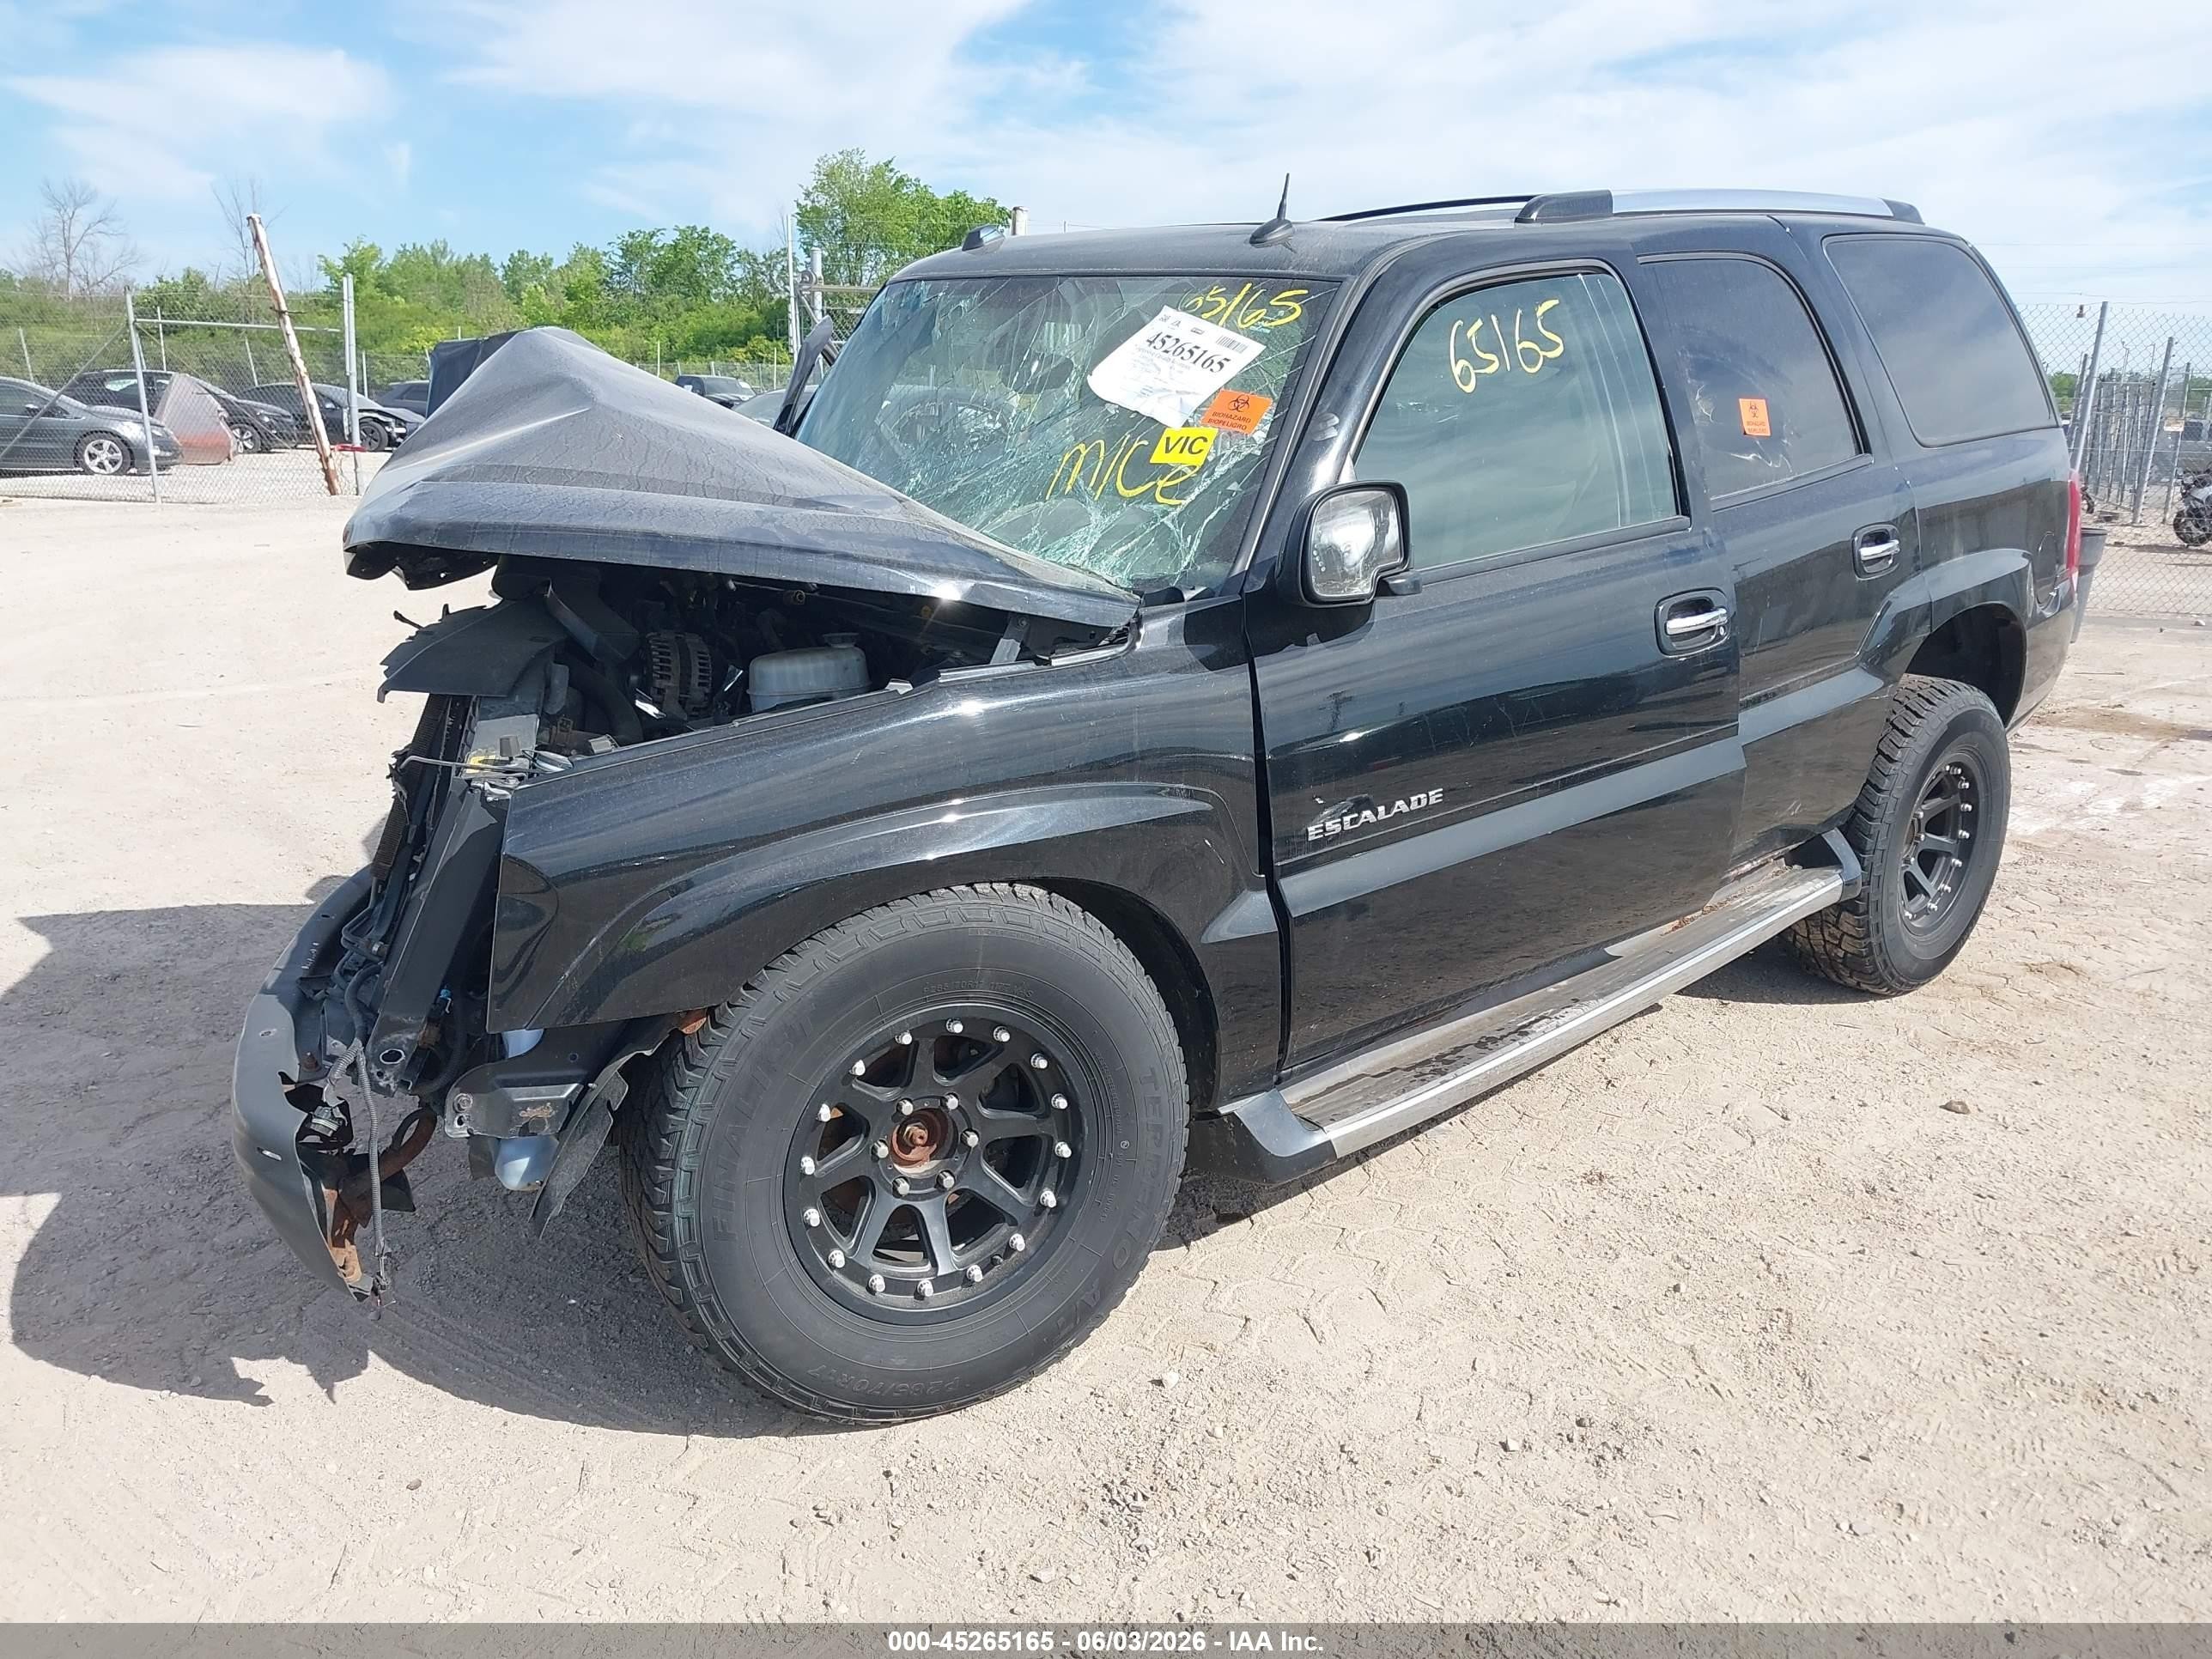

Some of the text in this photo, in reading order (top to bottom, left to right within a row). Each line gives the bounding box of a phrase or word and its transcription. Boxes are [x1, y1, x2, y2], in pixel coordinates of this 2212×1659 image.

[1146, 331, 1231, 373] 45265165
[1449, 299, 1565, 393] 65165
[1207, 418, 1247, 430] BIOPELIGRO
[1212, 411, 1252, 423] BIOHAZARD
[1164, 436, 1208, 455] VIC
[1307, 787, 1443, 842] ESCALADE
